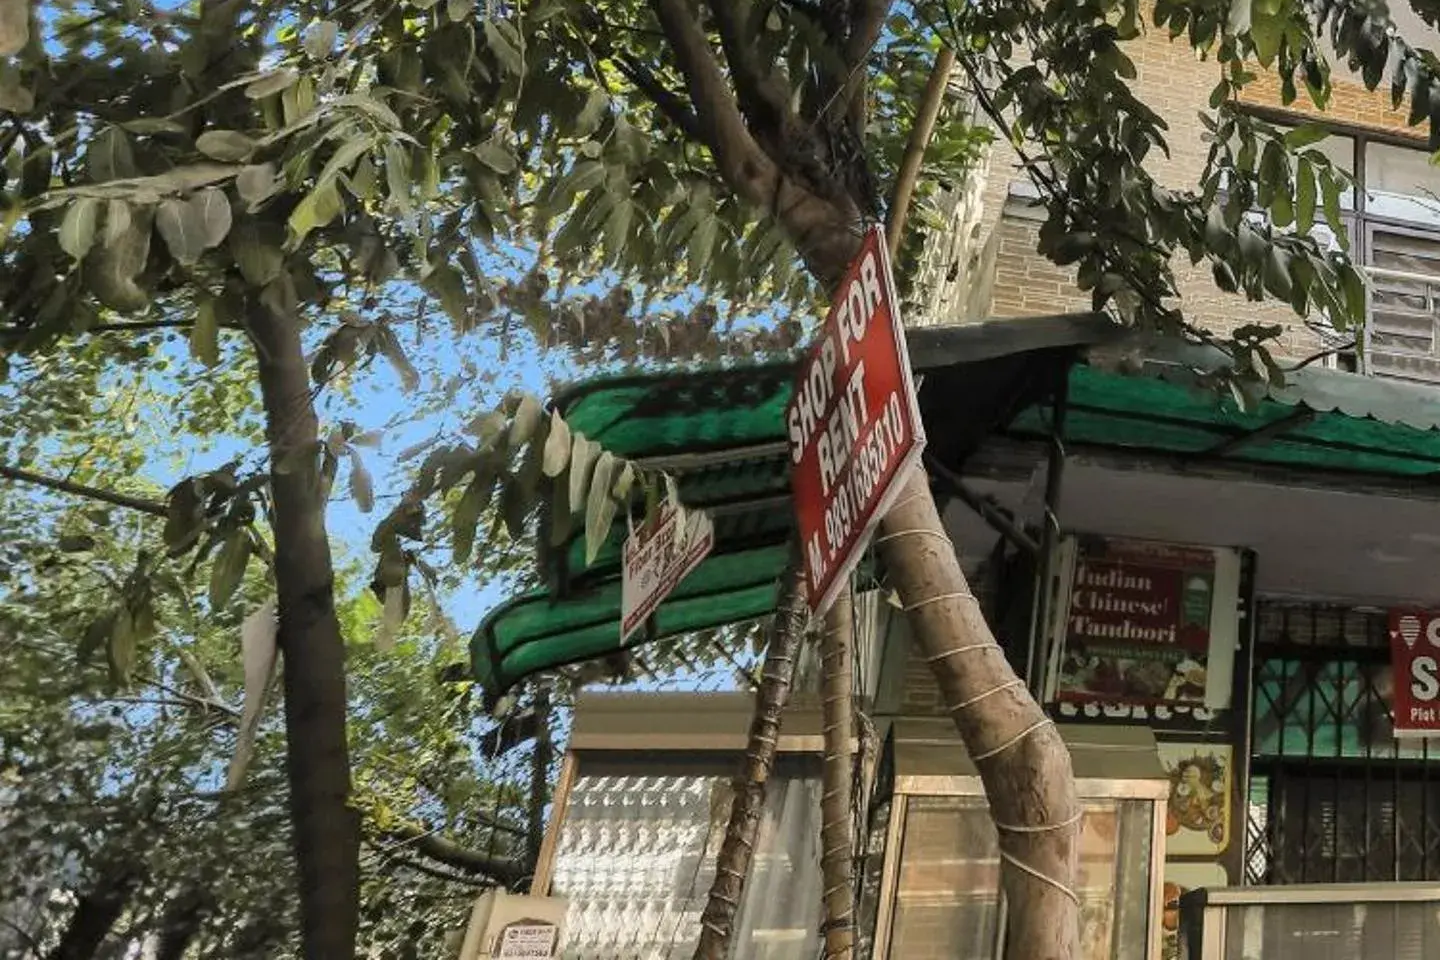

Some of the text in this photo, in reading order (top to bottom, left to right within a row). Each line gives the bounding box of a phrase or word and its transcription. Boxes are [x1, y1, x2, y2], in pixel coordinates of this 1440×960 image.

[789, 251, 882, 464] SHOP FOR
[817, 360, 868, 497] RENT
[824, 391, 904, 561] 9891685810
[1069, 614, 1177, 643] Tandoori
[1410, 707, 1434, 723] Plot
